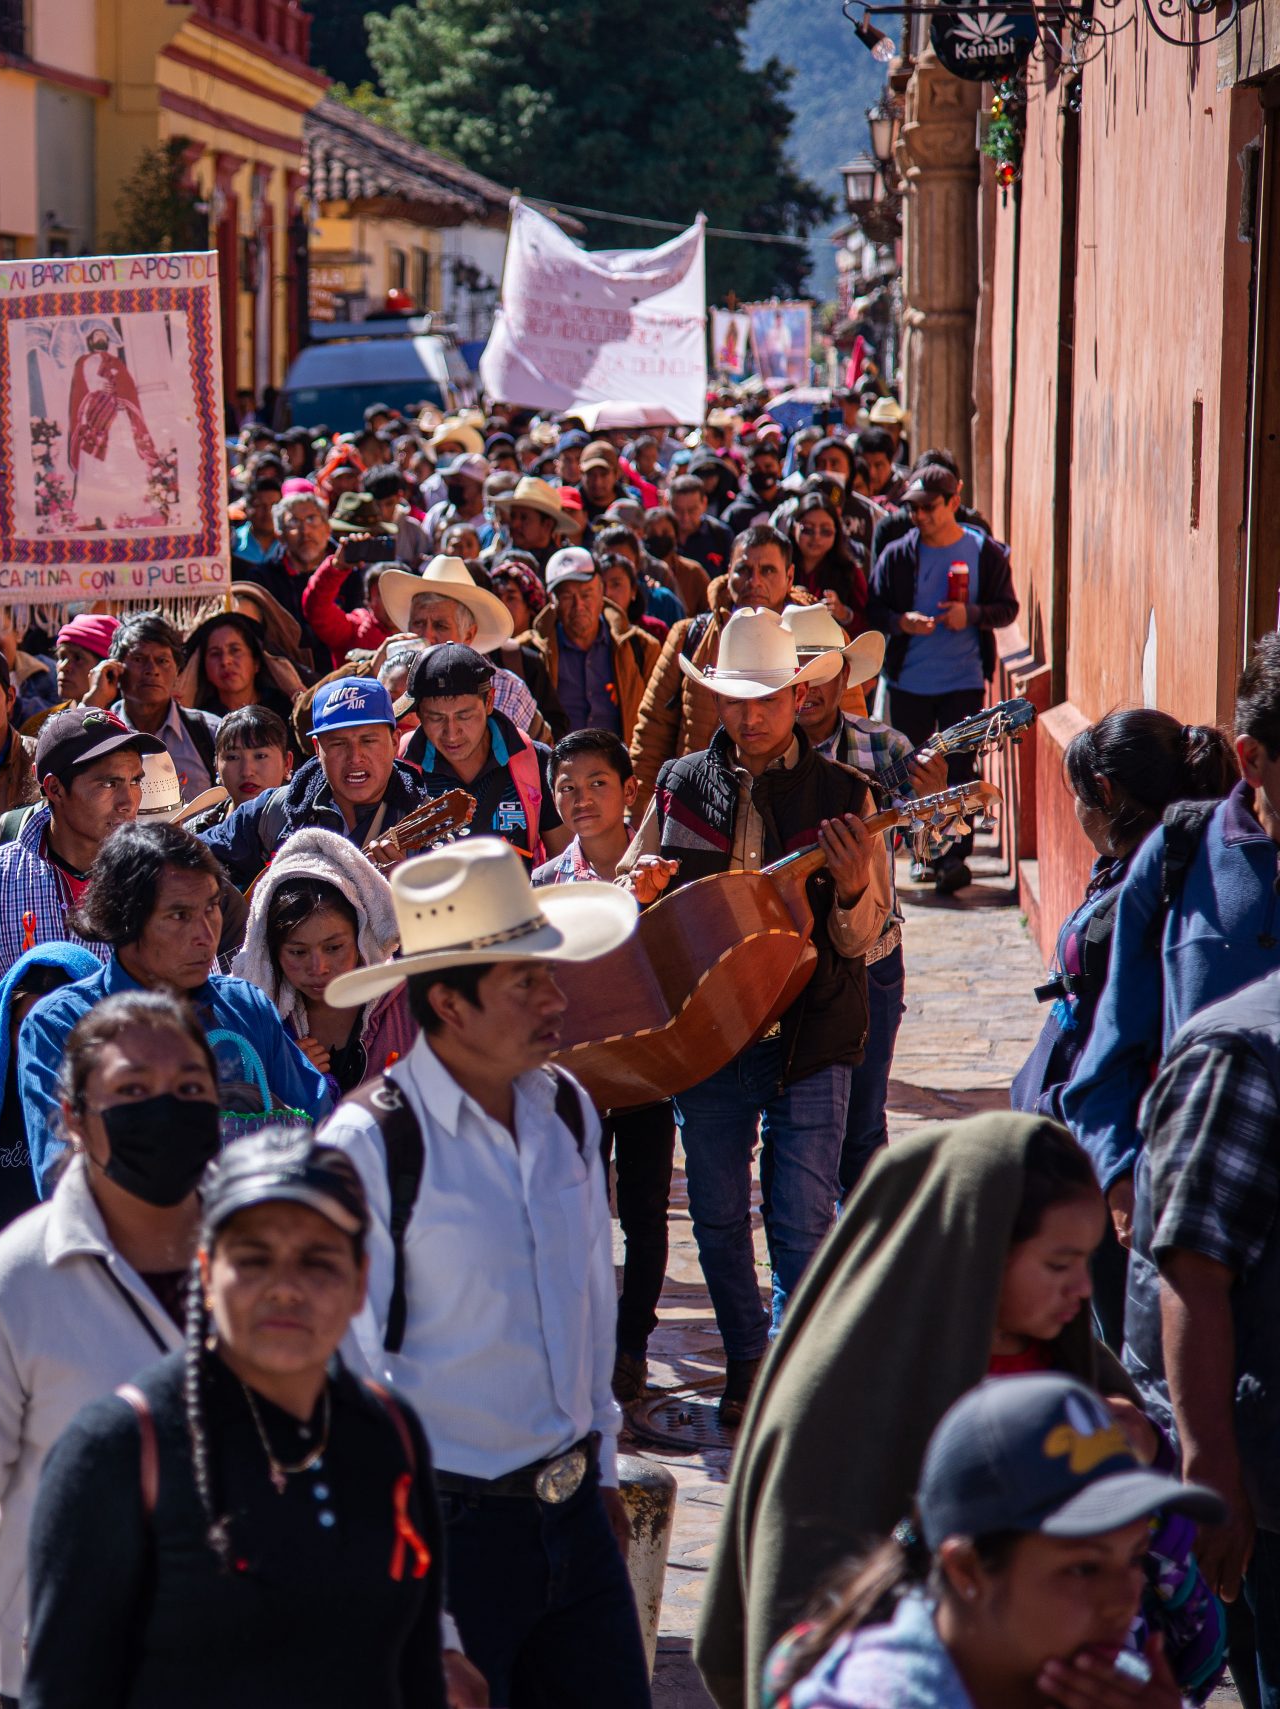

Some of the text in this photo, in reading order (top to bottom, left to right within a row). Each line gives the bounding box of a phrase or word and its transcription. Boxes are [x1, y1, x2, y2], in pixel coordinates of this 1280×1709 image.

[955, 37, 1014, 59] Kanabi
[130, 255, 218, 281] APOSTOL
[79, 570, 115, 589] CON
[121, 566, 143, 587] TU
[147, 563, 224, 588] PUEBLO
[328, 686, 360, 705] NIKE
[347, 699, 366, 710] AIR
